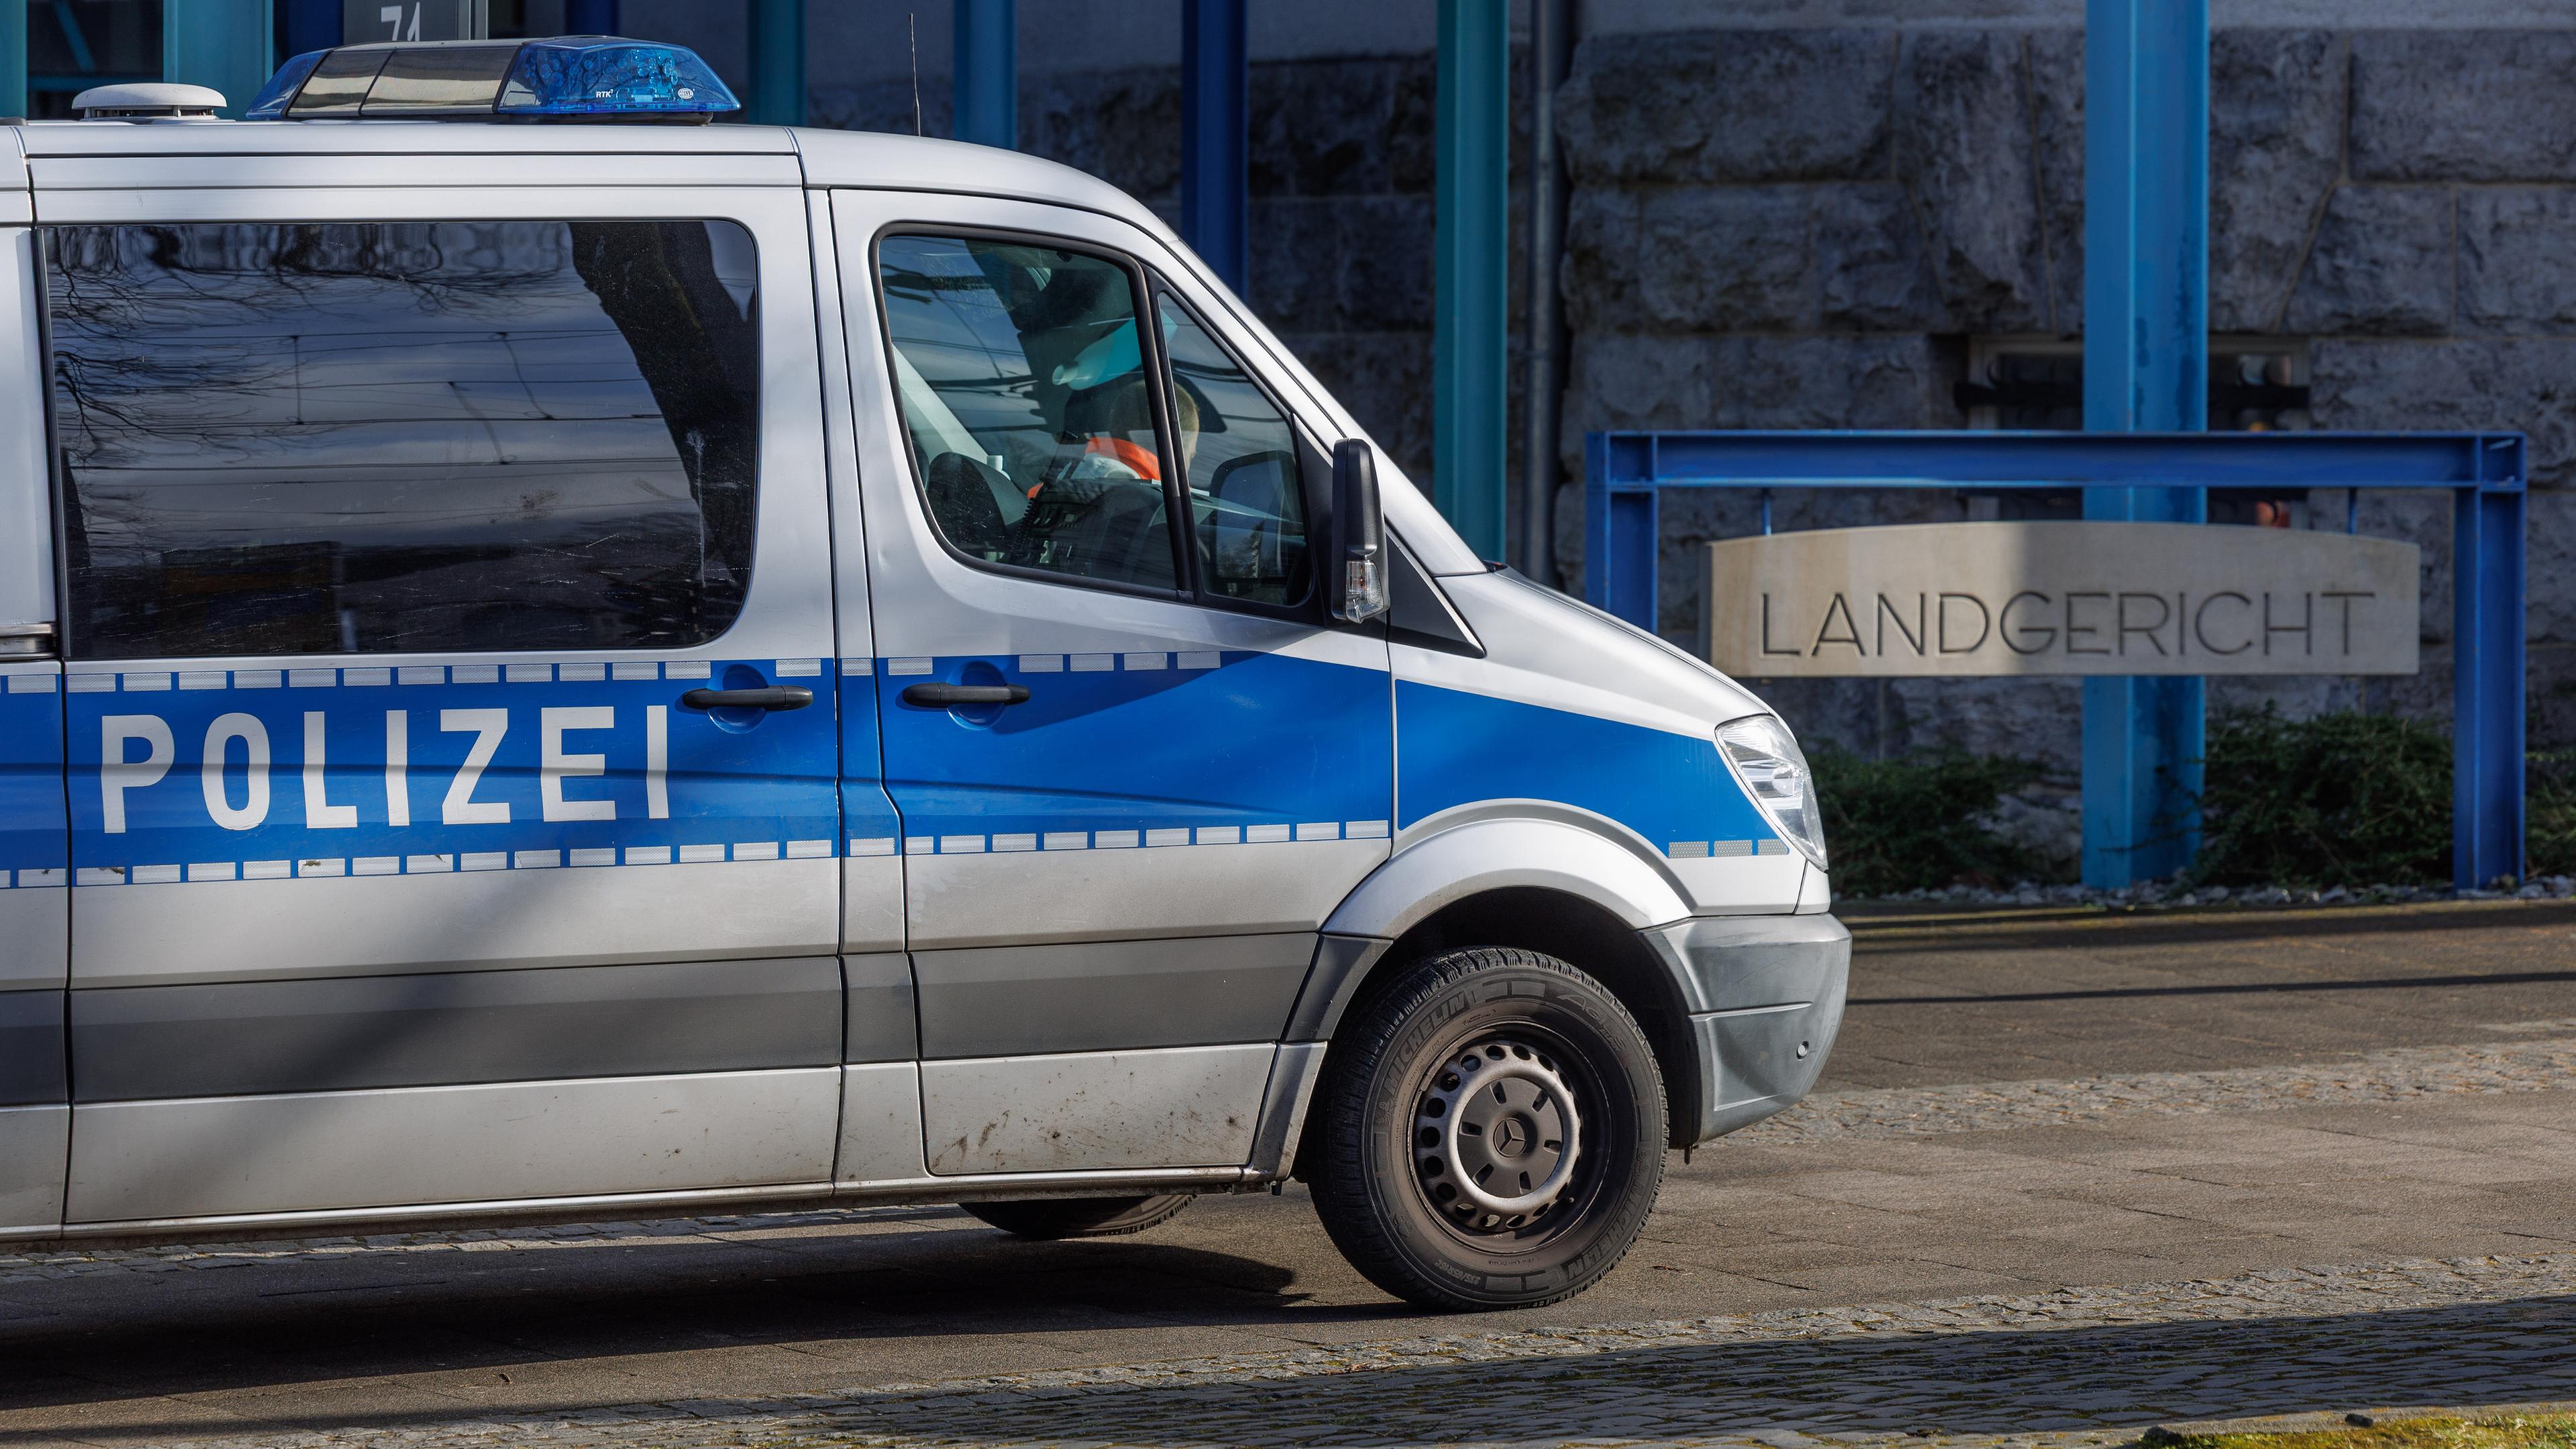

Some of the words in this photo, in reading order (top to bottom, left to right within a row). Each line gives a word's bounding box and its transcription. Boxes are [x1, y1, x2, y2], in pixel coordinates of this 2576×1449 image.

[1761, 591, 2375, 657] LANDGERICHT
[101, 705, 669, 834] POLIZEI
[1383, 991, 1468, 1096] MICHELIN
